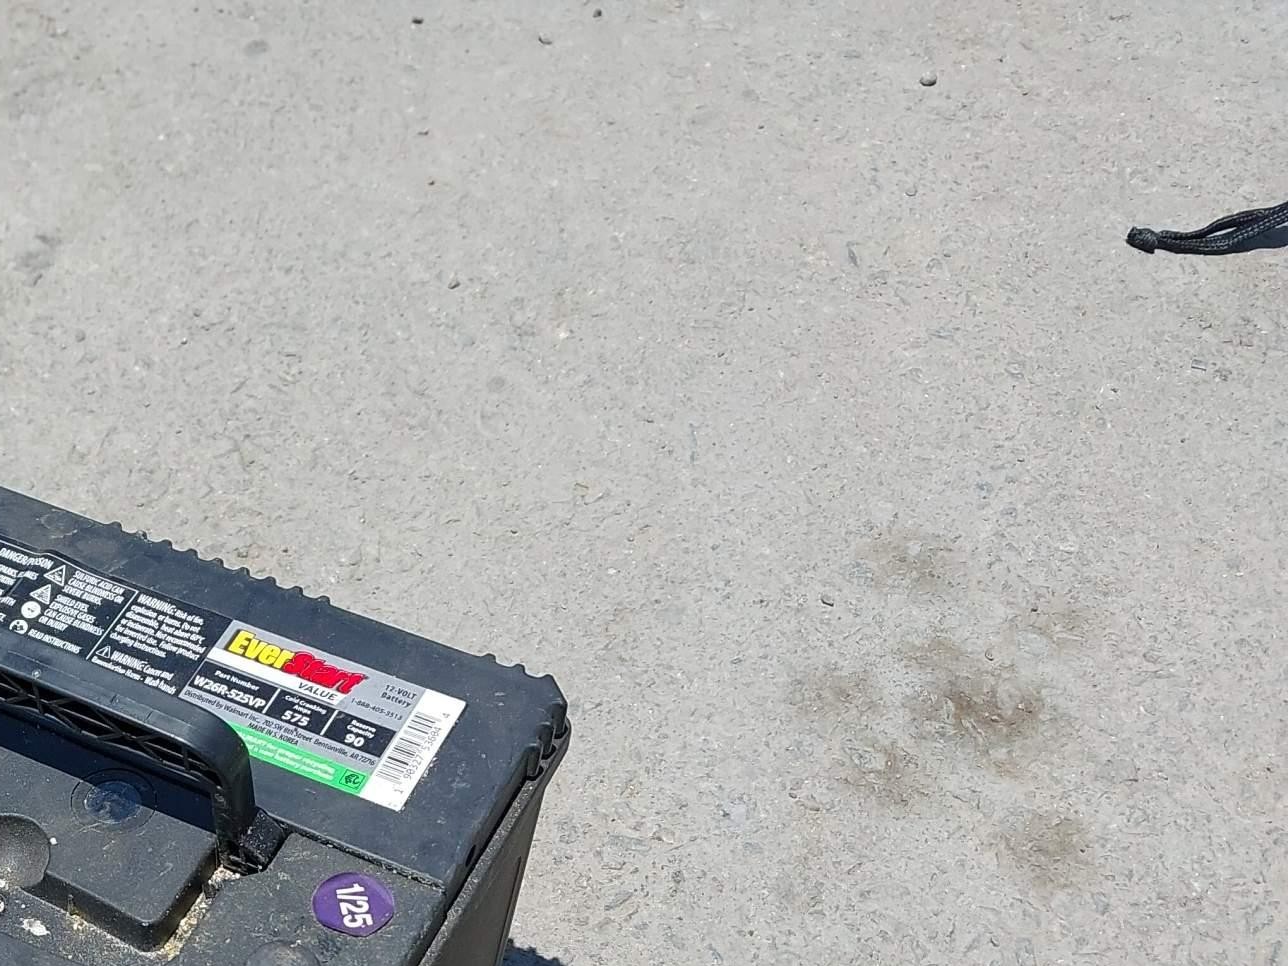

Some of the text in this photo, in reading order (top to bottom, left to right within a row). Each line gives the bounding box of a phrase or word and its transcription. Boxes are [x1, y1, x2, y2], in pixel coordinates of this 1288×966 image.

[137, 594, 177, 616] WARNING:
[226, 628, 366, 694] EverStart
[214, 670, 261, 691] Part Number
[193, 674, 267, 709] W26R-525VP
[298, 682, 339, 701] VALUE
[380, 692, 412, 708] Battery
[384, 684, 417, 700] 12-VOLT
[184, 689, 217, 706] Distributed
[223, 703, 249, 720] Walmart
[281, 710, 310, 727] 575
[350, 719, 377, 733] Reserve
[247, 722, 266, 735] MADE
[278, 733, 299, 747] KOREA
[344, 733, 366, 747] 90
[346, 725, 375, 739] Capacity
[336, 883, 373, 928] 1/25
